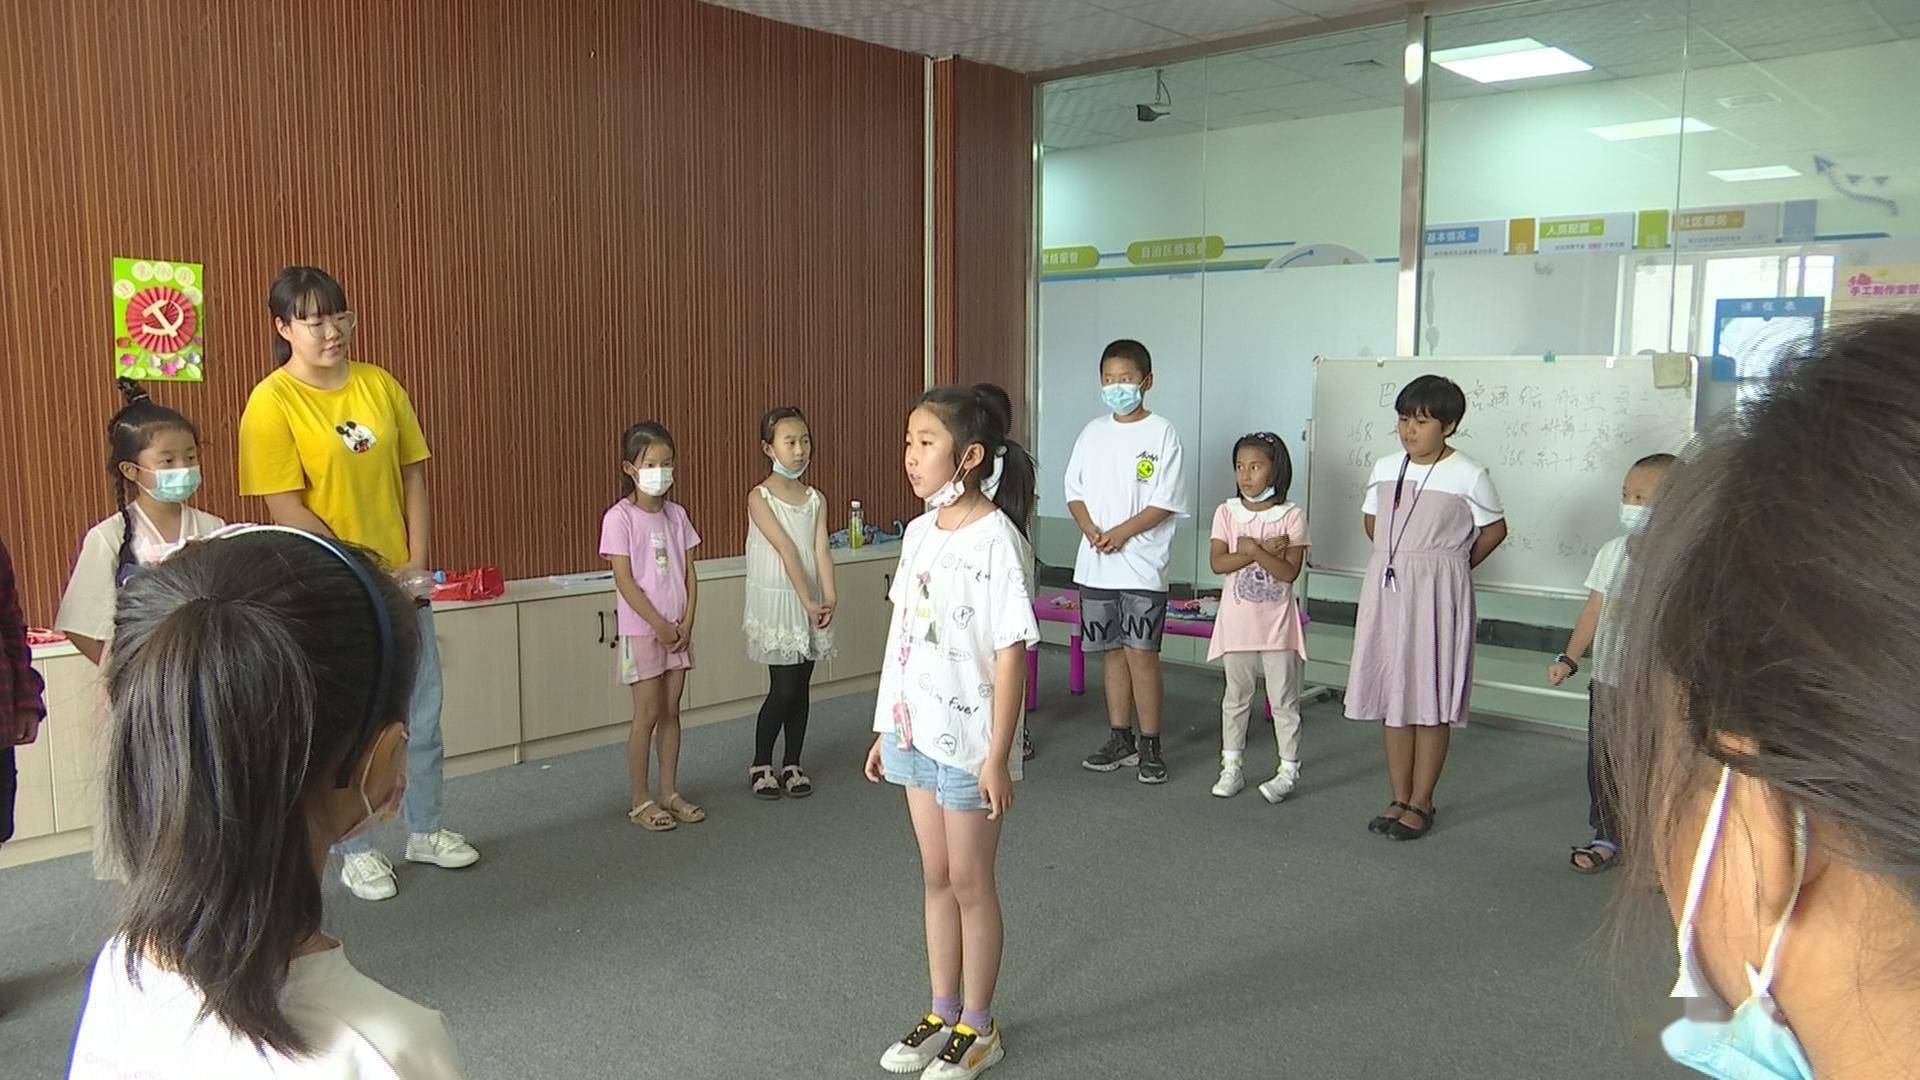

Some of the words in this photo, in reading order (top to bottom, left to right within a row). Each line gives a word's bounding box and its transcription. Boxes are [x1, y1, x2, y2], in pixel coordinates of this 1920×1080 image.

[1545, 222, 1590, 236] 人员配置
[1426, 230, 1467, 244] 基本情况
